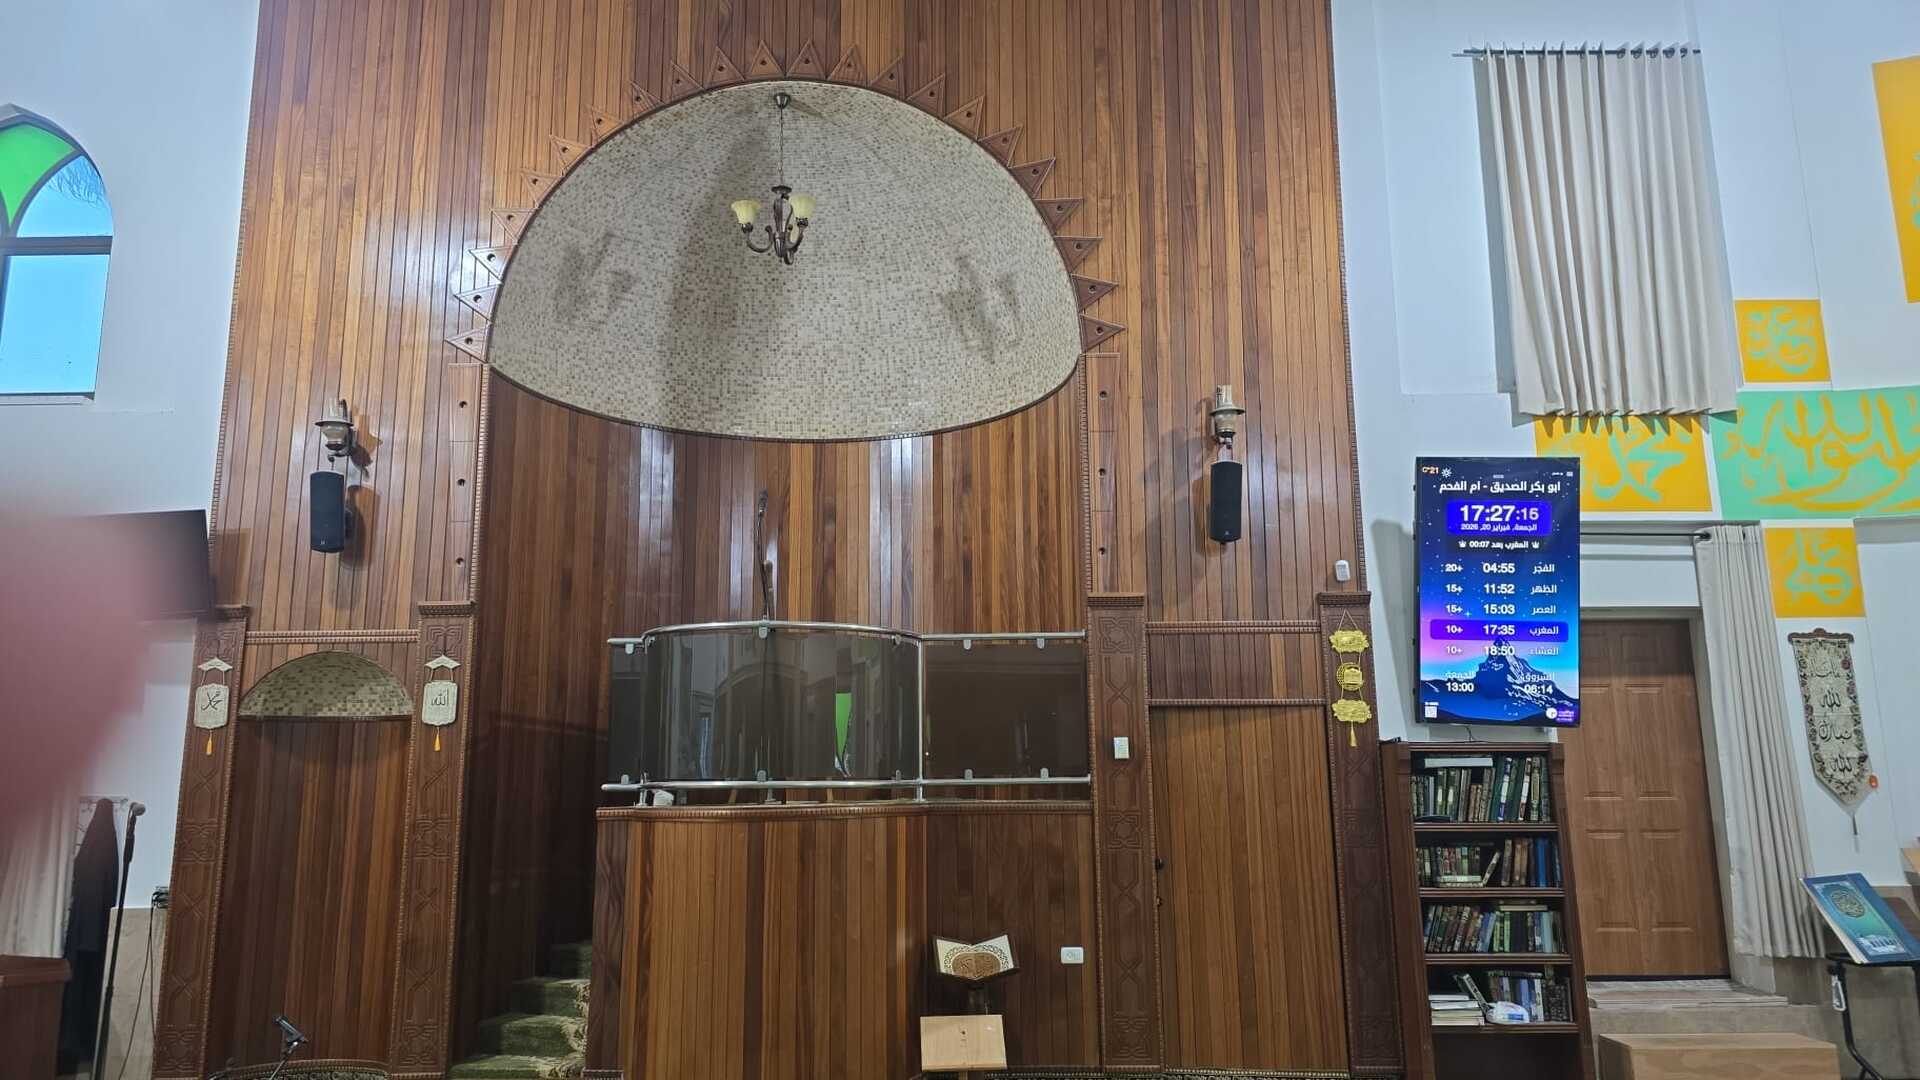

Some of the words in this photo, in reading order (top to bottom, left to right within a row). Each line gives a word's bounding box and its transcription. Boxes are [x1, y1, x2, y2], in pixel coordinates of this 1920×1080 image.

[1439, 481, 1467, 494] الفحم
[1490, 481, 1527, 493] الصديق
[1529, 481, 1545, 493] بكر
[1469, 540, 1490, 548] 00:07
[1482, 562, 1516, 574] 04:55
[1532, 563, 1555, 574] الفجر
[1483, 583, 1515, 595] 11:52
[1530, 584, 1557, 596] الظهر
[1483, 604, 1516, 615] 15:03
[1531, 604, 1556, 616] العصر
[1483, 624, 1516, 635] 17:35
[1529, 626, 1559, 637] المغرب
[1484, 645, 1515, 656] 18:50
[1445, 681, 1475, 692] 13:00
